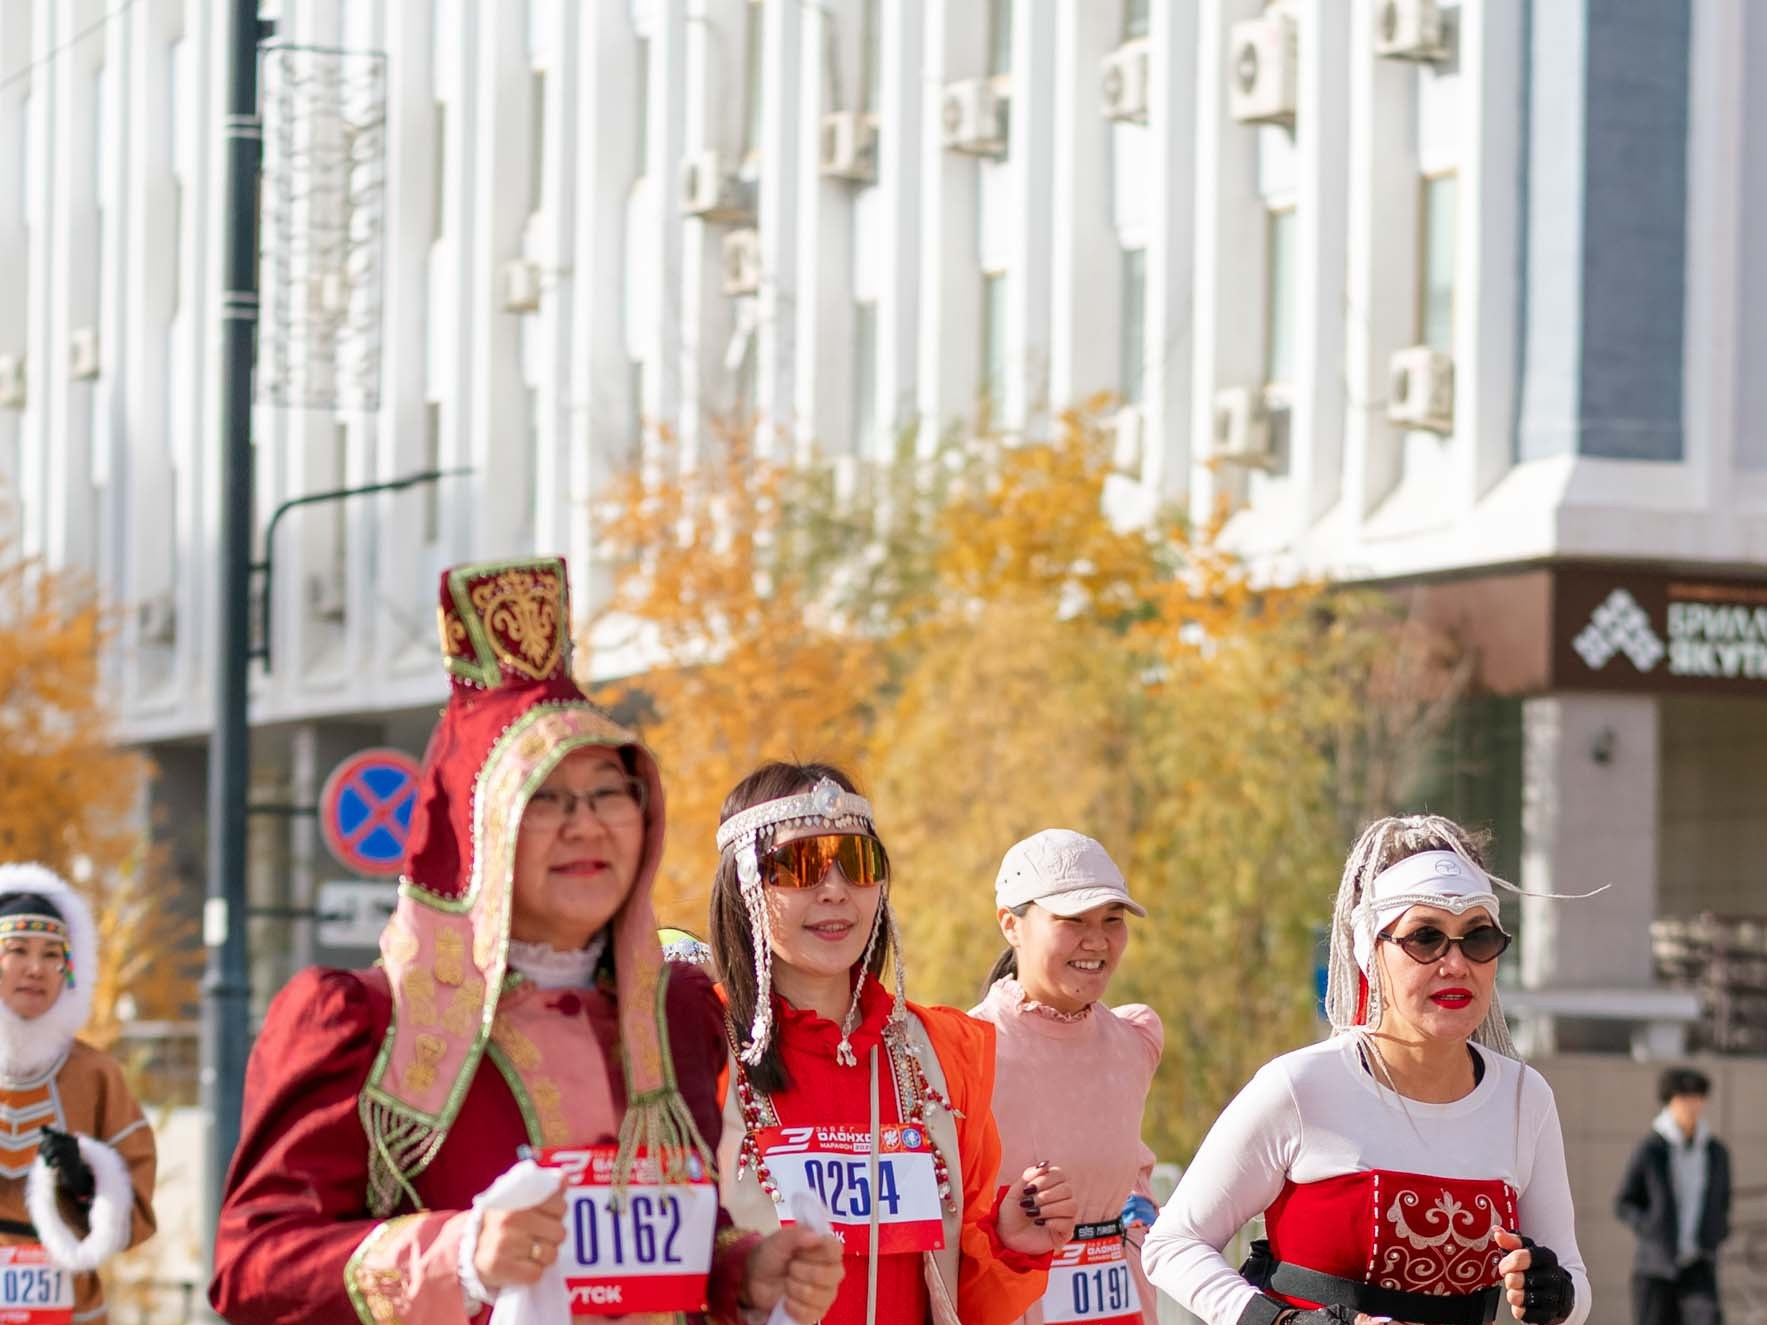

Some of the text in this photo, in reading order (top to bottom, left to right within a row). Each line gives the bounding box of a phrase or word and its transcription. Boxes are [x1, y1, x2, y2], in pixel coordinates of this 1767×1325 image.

[804, 1160, 900, 1216] 0254
[575, 1195, 682, 1265] 0162
[5, 1269, 61, 1302] 0251
[1072, 1265, 1129, 1314] 0197
